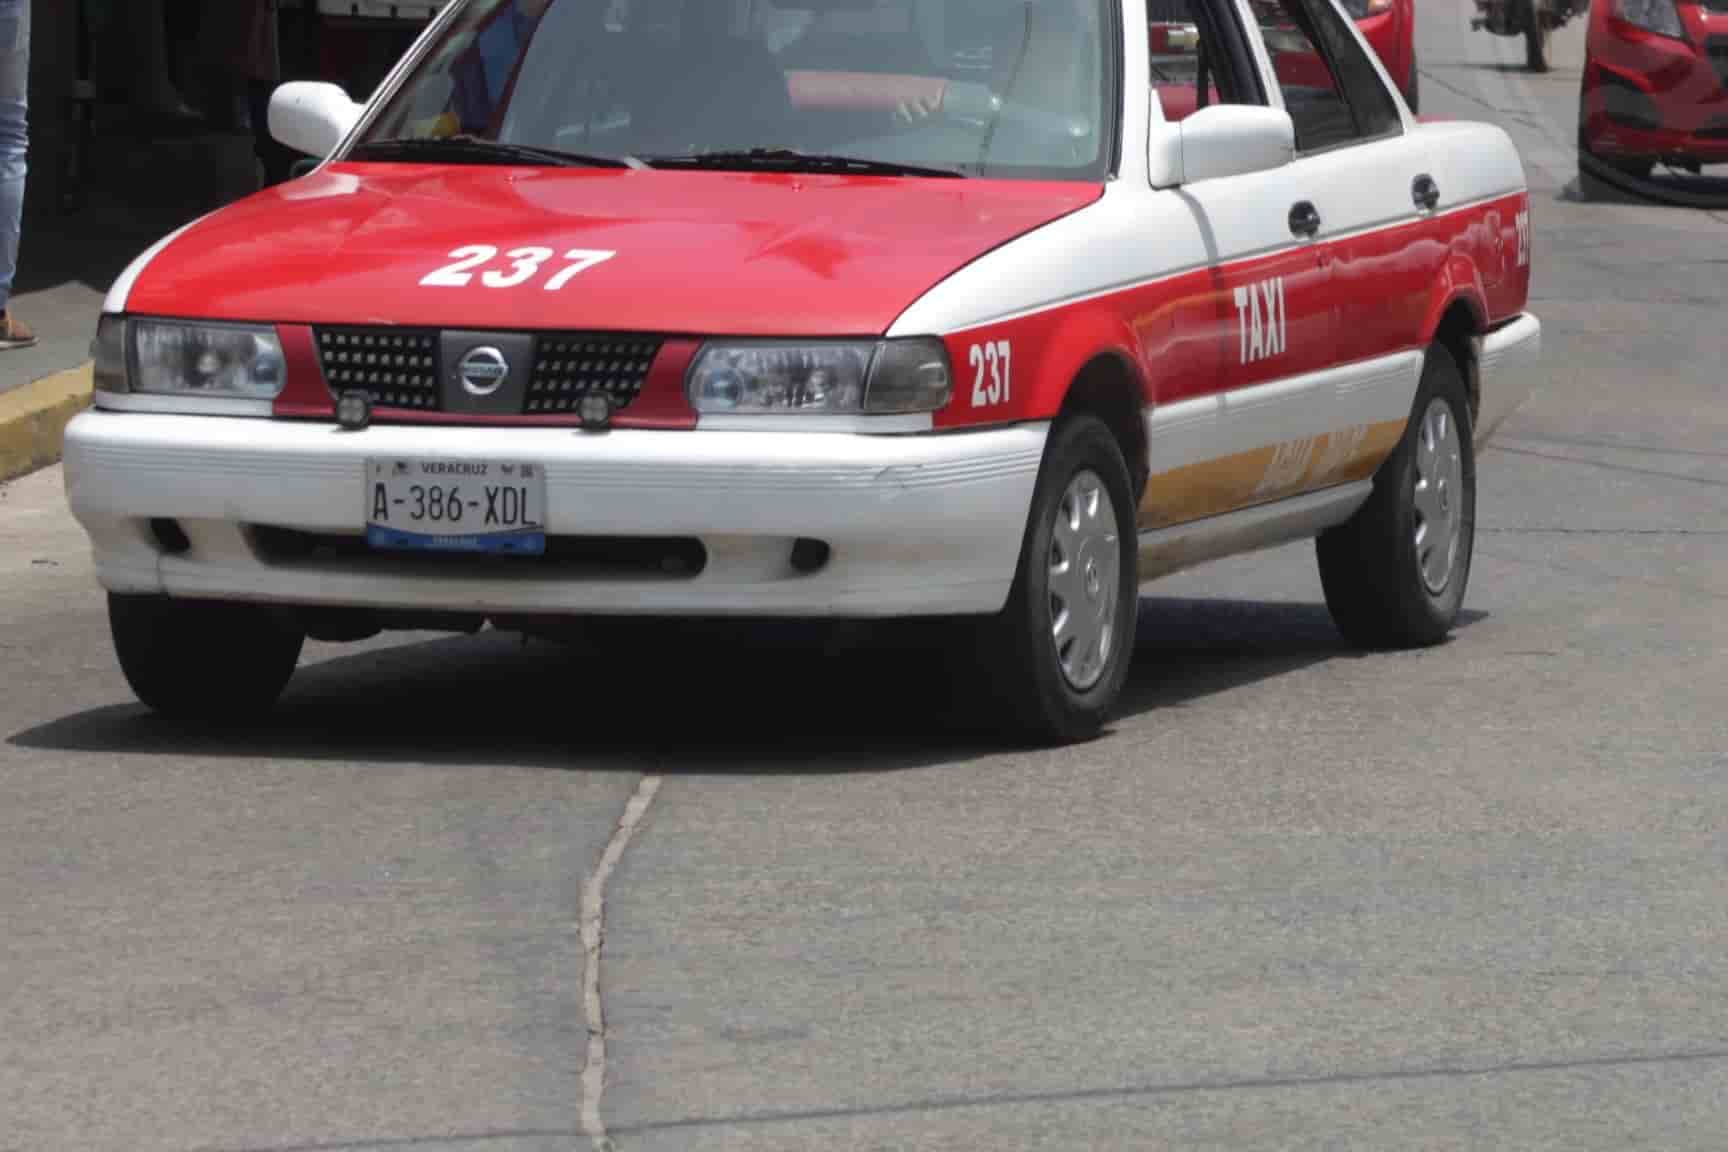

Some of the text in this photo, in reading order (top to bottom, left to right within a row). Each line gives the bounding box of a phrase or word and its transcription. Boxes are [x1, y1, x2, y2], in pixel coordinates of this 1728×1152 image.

[418, 244, 617, 290] 237
[1233, 276, 1286, 365] TAXI
[969, 339, 1011, 408] 237
[421, 462, 489, 475] VERACRUZ
[372, 482, 537, 526] A-386-XDL
